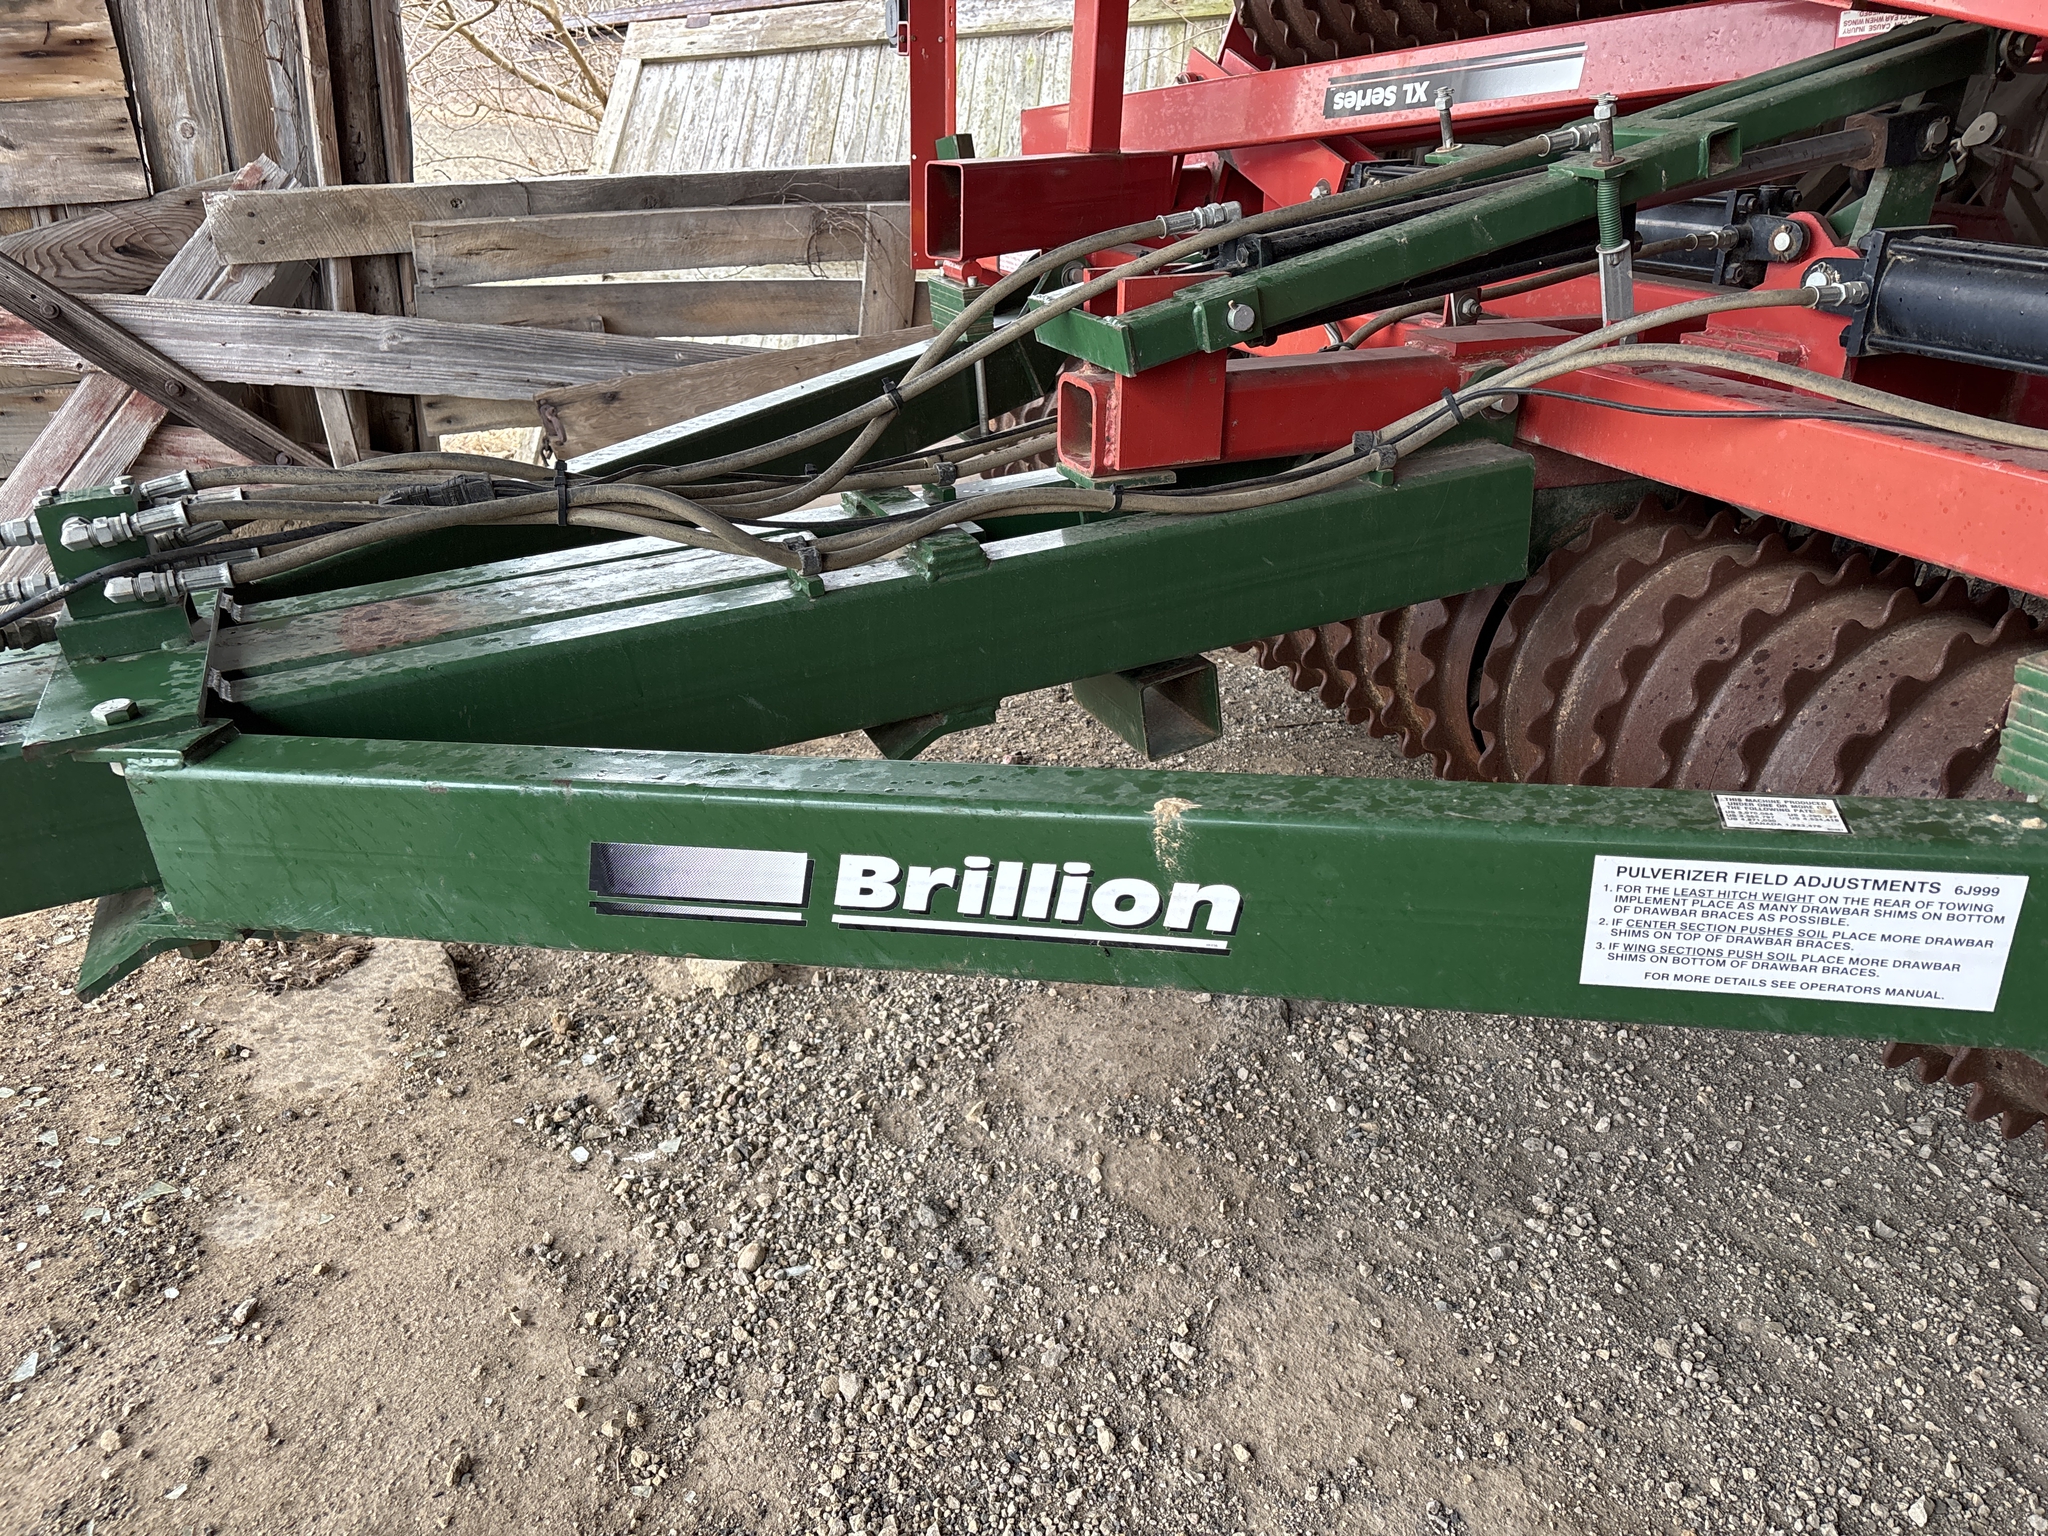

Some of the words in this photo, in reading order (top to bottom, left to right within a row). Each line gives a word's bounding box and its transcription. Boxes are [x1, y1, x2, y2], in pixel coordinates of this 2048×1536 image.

[1843, 19, 1863, 27] WINGS
[1843, 26, 1865, 34] INJURY
[1333, 85, 1398, 111] Series
[1402, 81, 1430, 104] XL
[1615, 866, 1728, 882] PULVERIZER
[1733, 872, 1788, 885] FIELD
[1793, 875, 1942, 893] ADJUSTMENTS
[1953, 884, 2001, 896] 6J999
[834, 854, 1243, 935] Brillion
[1615, 885, 1641, 893] FOR
[1644, 886, 1670, 894] THE
[1672, 888, 1714, 897] LEAST
[1716, 890, 1757, 899] HITCH
[1760, 892, 1815, 902] WEIGHT
[1817, 895, 1838, 904] ON
[1841, 897, 1869, 905] THE
[1872, 898, 1911, 907] REAR
[1913, 900, 1934, 909] OF
[1936, 902, 1994, 912] TOWING
[1612, 905, 1630, 913] OF
[1633, 906, 1697, 917] DRAWBAR
[1700, 910, 1754, 920] BRACES
[1757, 913, 1775, 921] AS
[1778, 914, 1850, 925] POSSIBLE.
[1614, 895, 1688, 906] IMPLEMENT
[1691, 899, 1734, 909] PLACE
[1736, 902, 1755, 910] AS
[1758, 903, 1797, 912] MANY
[1800, 905, 1870, 916] DRAWBAR
[1873, 909, 1918, 919] SHIMS
[1920, 912, 1942, 920] ON
[1945, 913, 2005, 924] BOTTOM
[1598, 917, 1609, 925] 2.
[1625, 919, 1676, 929] CENTER
[1679, 922, 1736, 932] SECTION
[1739, 926, 1794, 936] PUSHES
[1796, 929, 1829, 938] SOIL
[1831, 931, 1877, 940] PLACE
[1879, 934, 1921, 943] MORE
[1924, 936, 1994, 947] DRAWBAR
[1610, 928, 1650, 937] SHIMS
[1652, 931, 1672, 939] ON
[1674, 932, 1701, 940] TOP
[1704, 934, 1722, 942] OF
[1725, 935, 1792, 946] DRAWBAR
[1795, 939, 1854, 950] BRACES.
[1606, 952, 1646, 962] SHIMS
[1649, 955, 1668, 963] ON
[1671, 957, 1726, 967] BOTTOM
[1729, 960, 1747, 968] OF
[1750, 962, 1818, 973] DRAWBAR
[1821, 966, 1880, 977] BRACES.
[1622, 943, 1656, 952] WING
[1659, 945, 1724, 956] SECTIONS
[1727, 949, 1763, 958] PUSH
[1766, 952, 1797, 960] SOIL
[1800, 954, 1845, 963] PLACE
[1848, 957, 1889, 966] MORE
[1892, 960, 1961, 971] DRAWBAR
[1643, 972, 1669, 980] FOR
[1672, 974, 1710, 983] MORE
[1713, 977, 1767, 987] DETAILS
[1770, 980, 1796, 989] SEE
[1798, 982, 1881, 994] OPERATORS
[1884, 988, 1945, 999] MANUAL.
